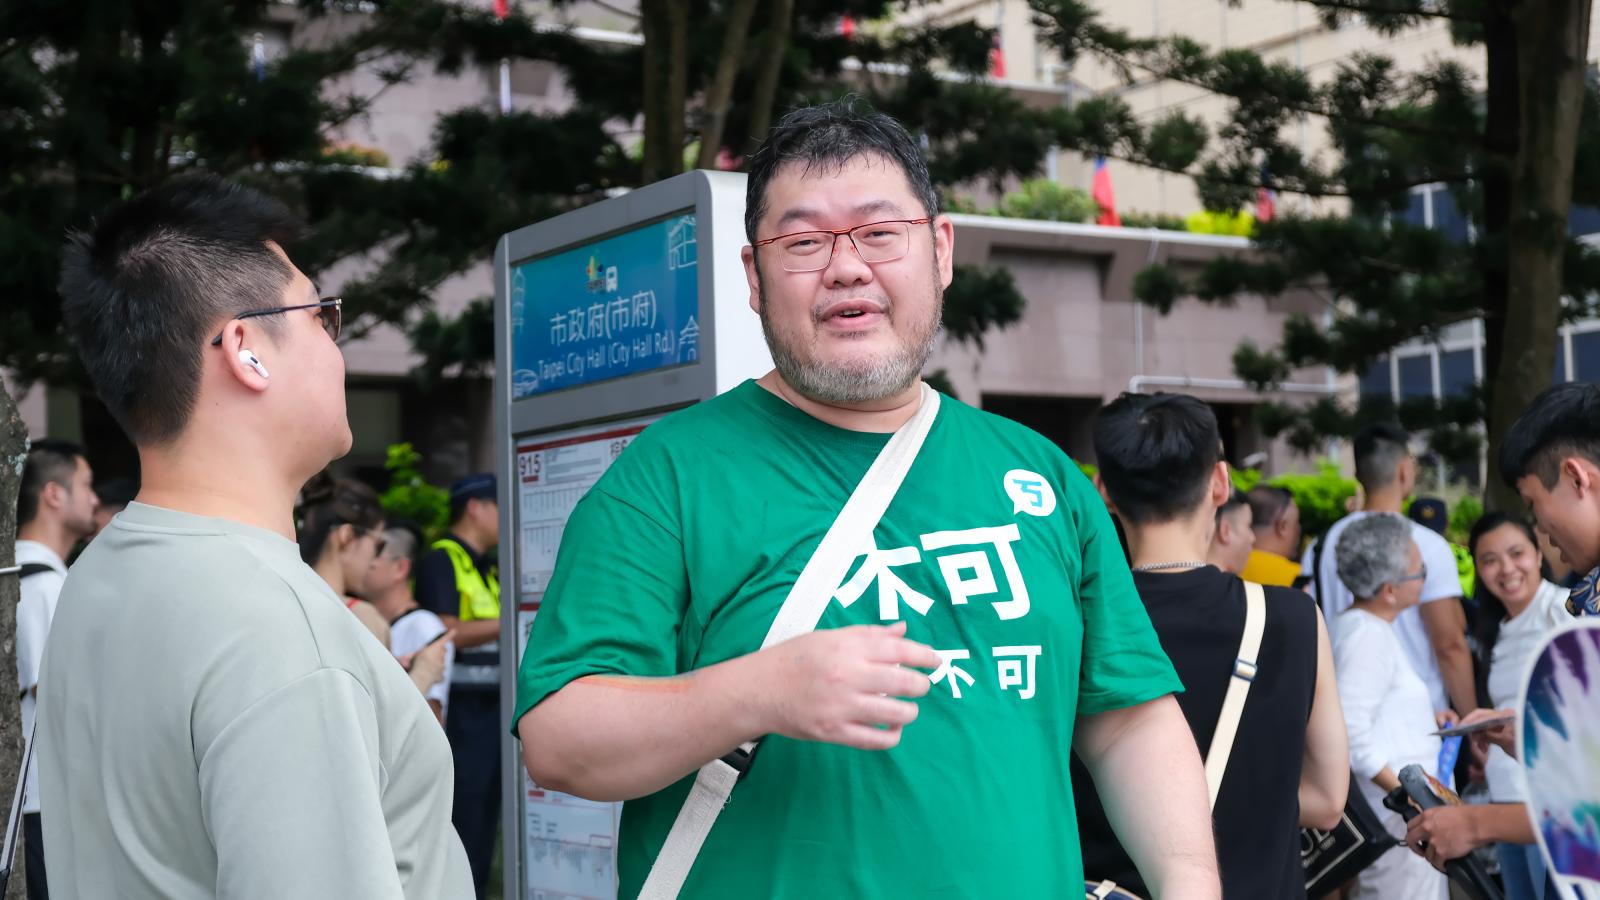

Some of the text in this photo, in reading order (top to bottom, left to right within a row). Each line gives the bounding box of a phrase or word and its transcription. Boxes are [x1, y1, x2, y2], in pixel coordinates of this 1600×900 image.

[550, 289, 657, 346] 市政府(市府)
[538, 329, 676, 382] Taipei City Hall (City Hall Rd.)
[519, 453, 541, 476] 915
[833, 523, 1031, 621] 不可
